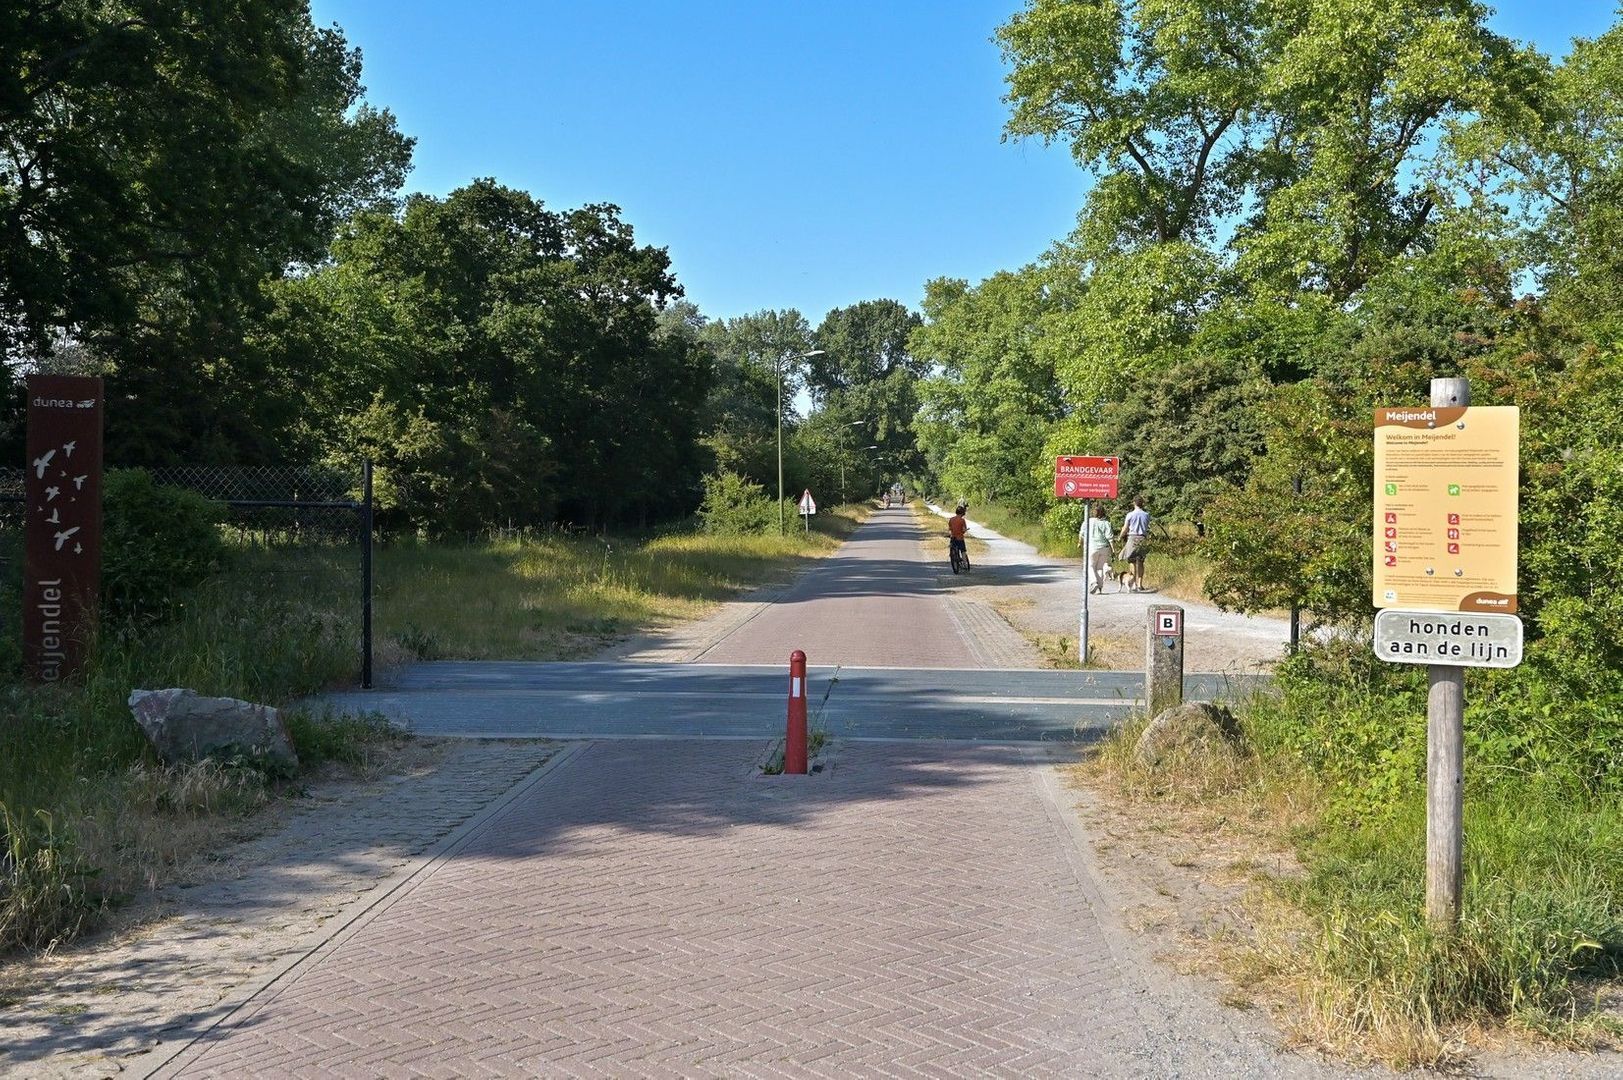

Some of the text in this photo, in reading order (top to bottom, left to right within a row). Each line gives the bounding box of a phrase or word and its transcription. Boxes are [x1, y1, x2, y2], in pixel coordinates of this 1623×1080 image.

[33, 397, 73, 408] dunea
[1385, 410, 1436, 423] Meijendel
[1422, 434, 1456, 442] Meijendel!
[1060, 465, 1114, 474] BRANDGEVAAR
[1163, 617, 1173, 628] B
[1409, 620, 1489, 636] honden
[37, 578, 65, 682] eijendel
[1390, 641, 1508, 662] aan de lijn
